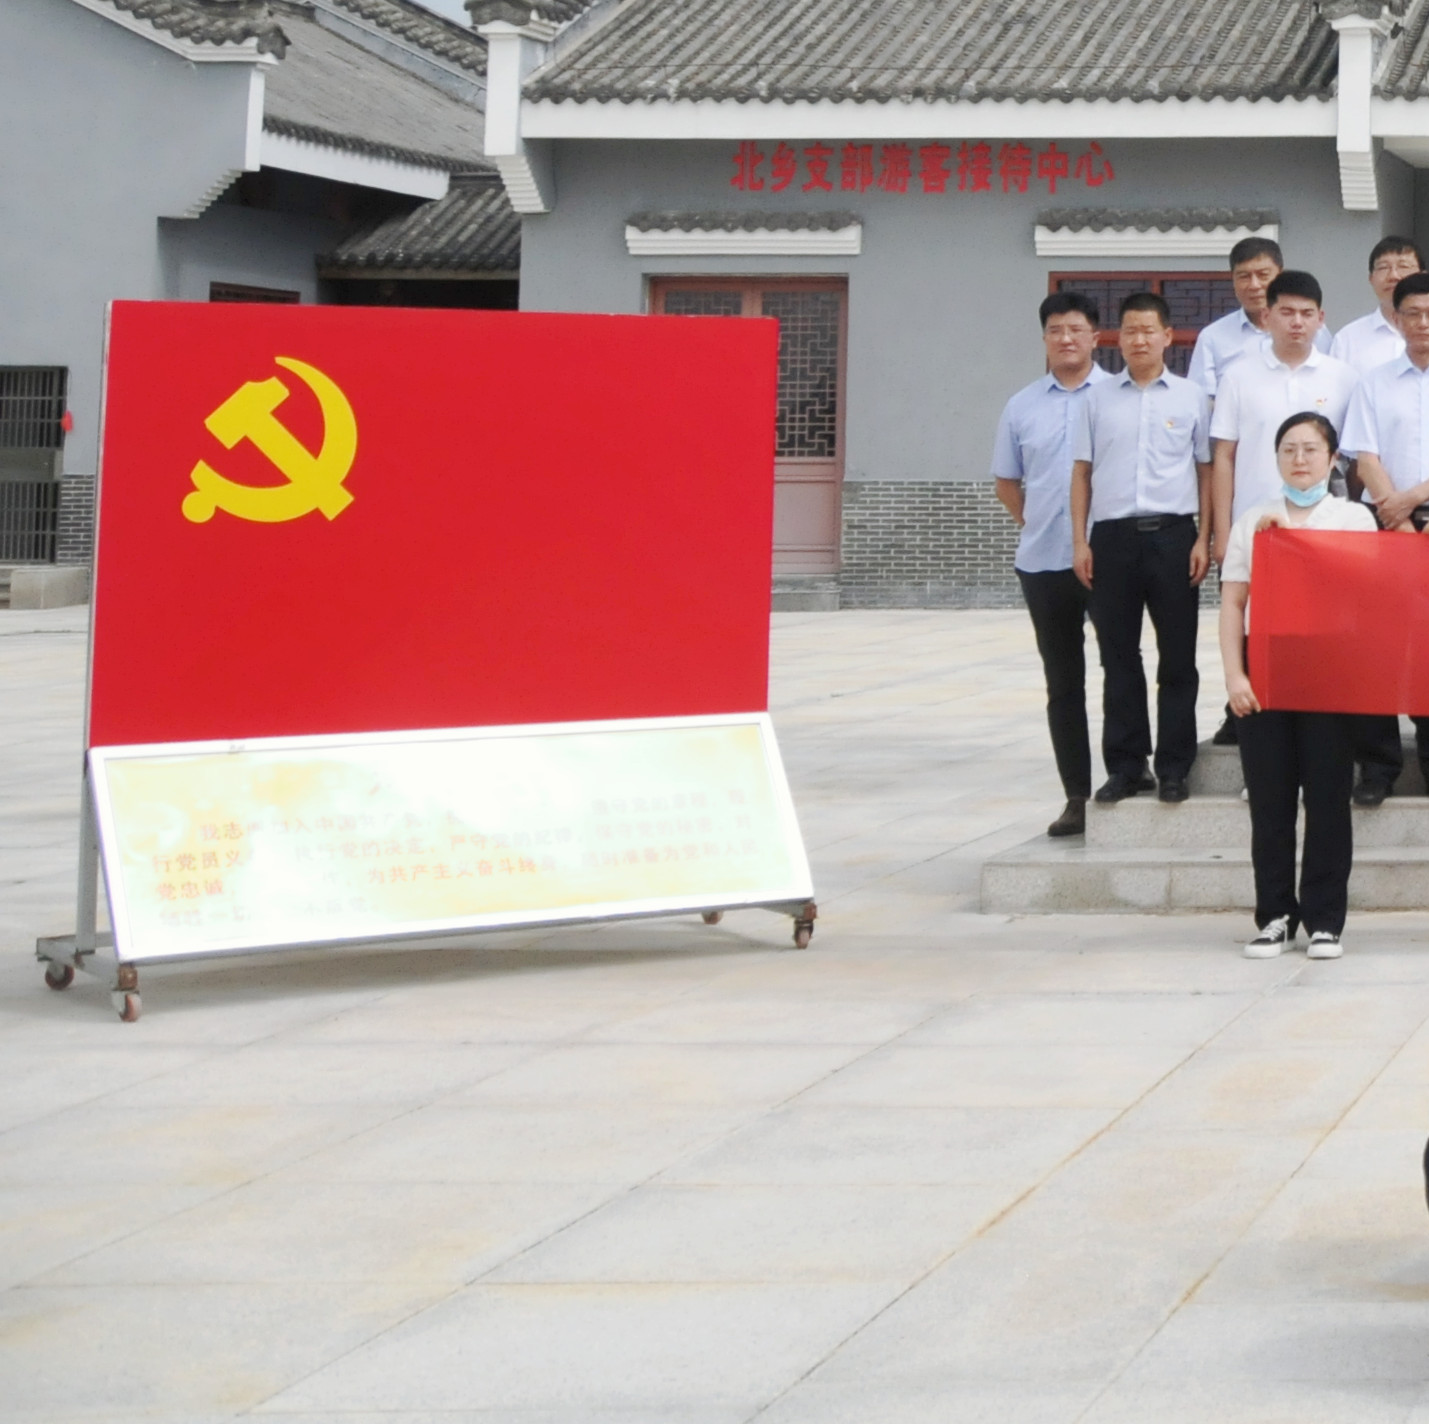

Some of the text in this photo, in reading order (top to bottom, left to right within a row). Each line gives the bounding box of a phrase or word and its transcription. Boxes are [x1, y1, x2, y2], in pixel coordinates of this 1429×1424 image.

[730, 140, 1115, 194] 北乡支部游客接待中心
